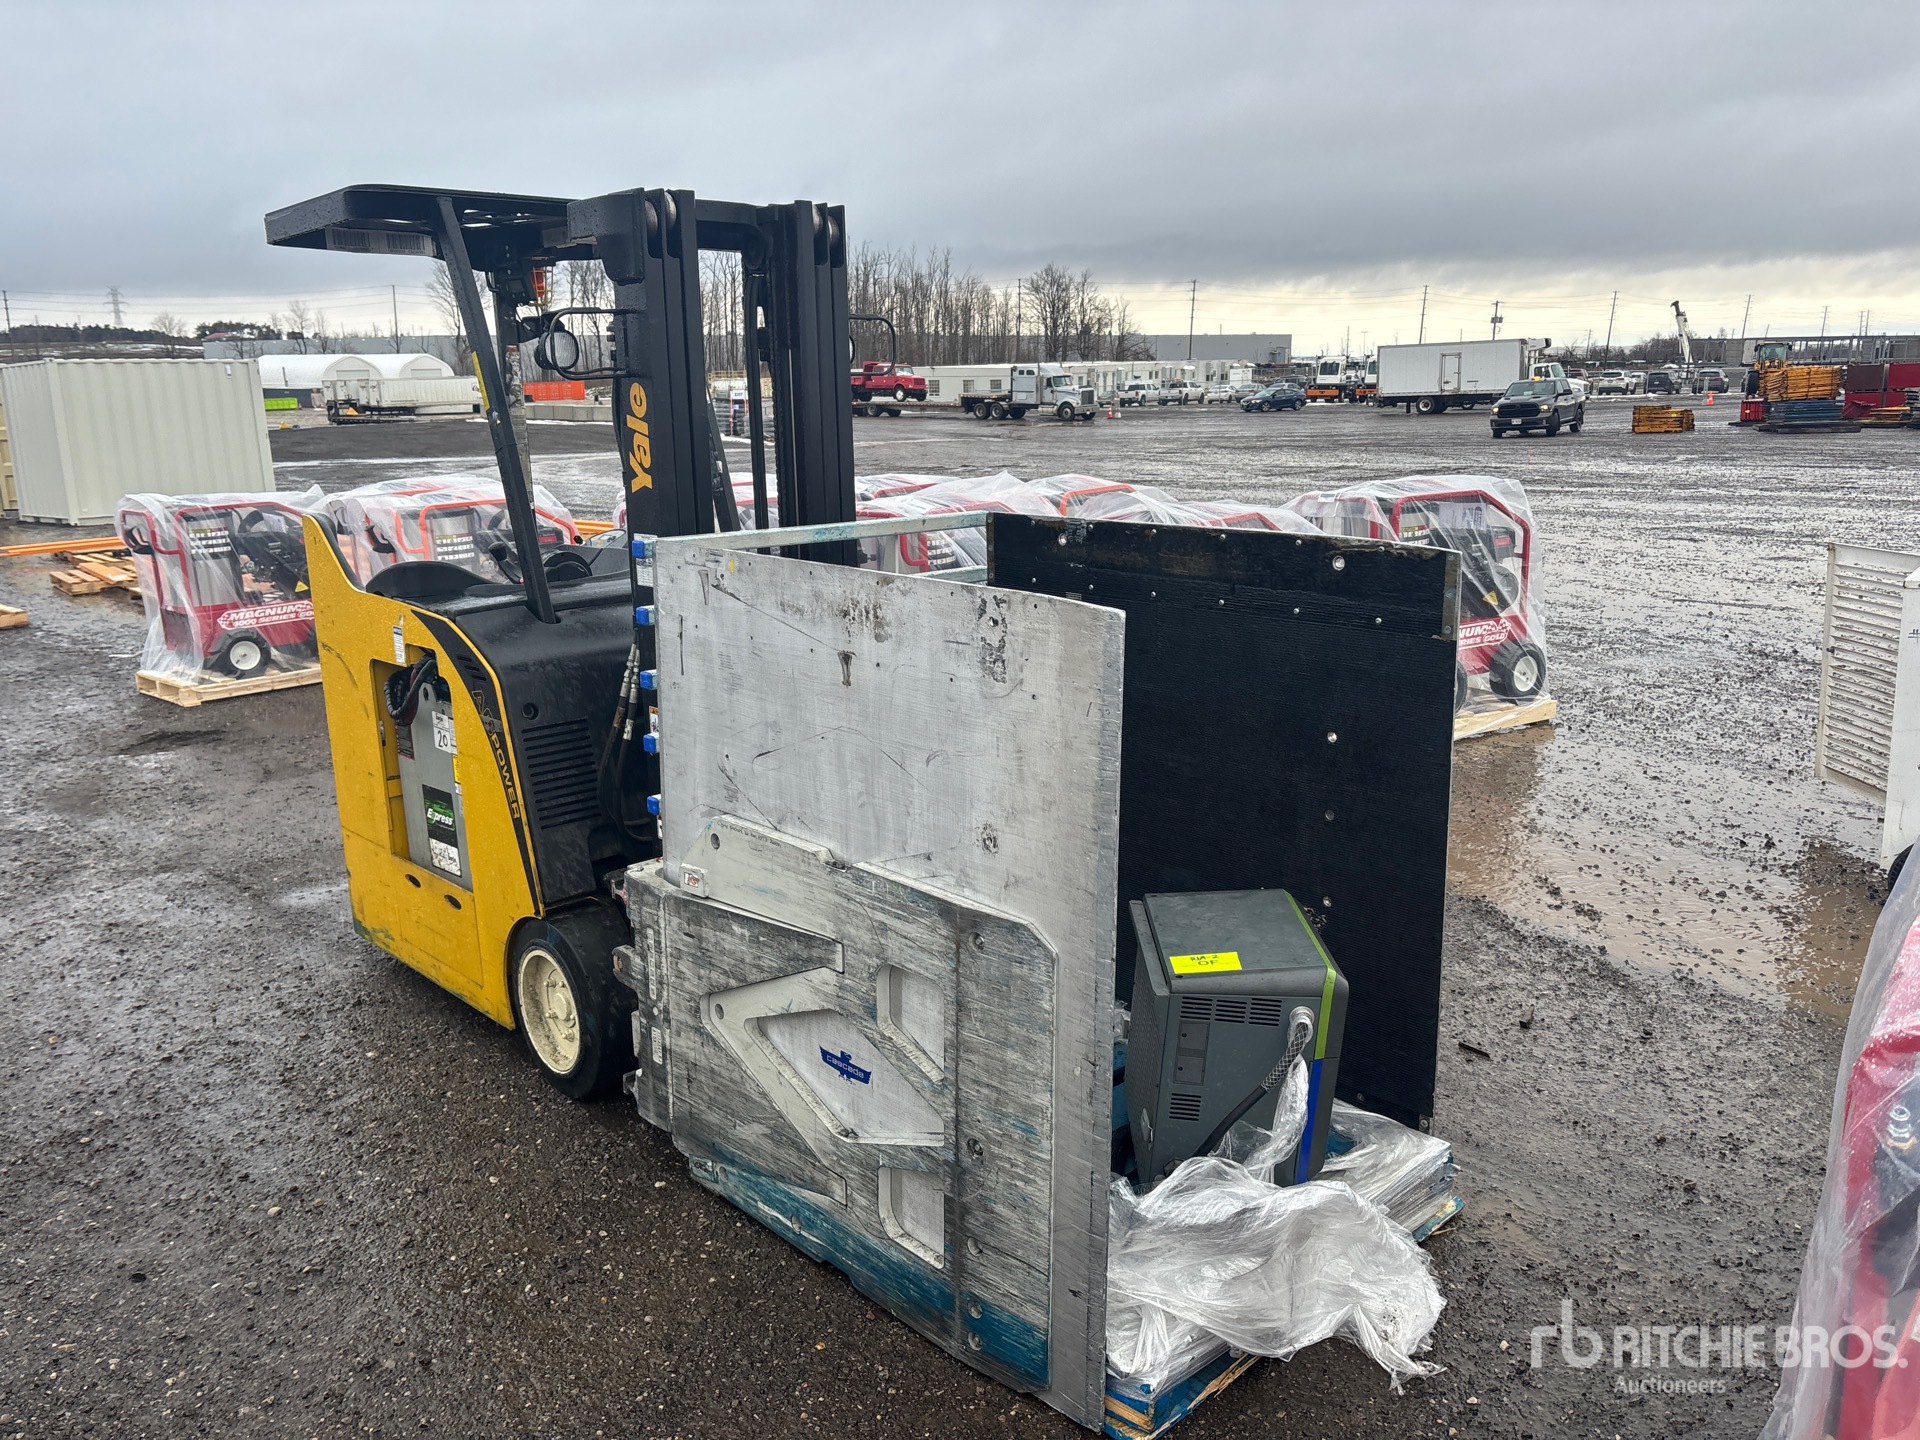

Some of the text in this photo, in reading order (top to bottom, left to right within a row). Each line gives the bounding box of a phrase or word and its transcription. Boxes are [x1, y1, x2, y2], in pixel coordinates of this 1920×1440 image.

[626, 382, 653, 493] Yale
[229, 603, 301, 620] MAGNUM
[258, 613, 296, 623] SERIES
[299, 610, 314, 618] GO
[1484, 632, 1505, 642] GOLD
[437, 730, 448, 747] 20
